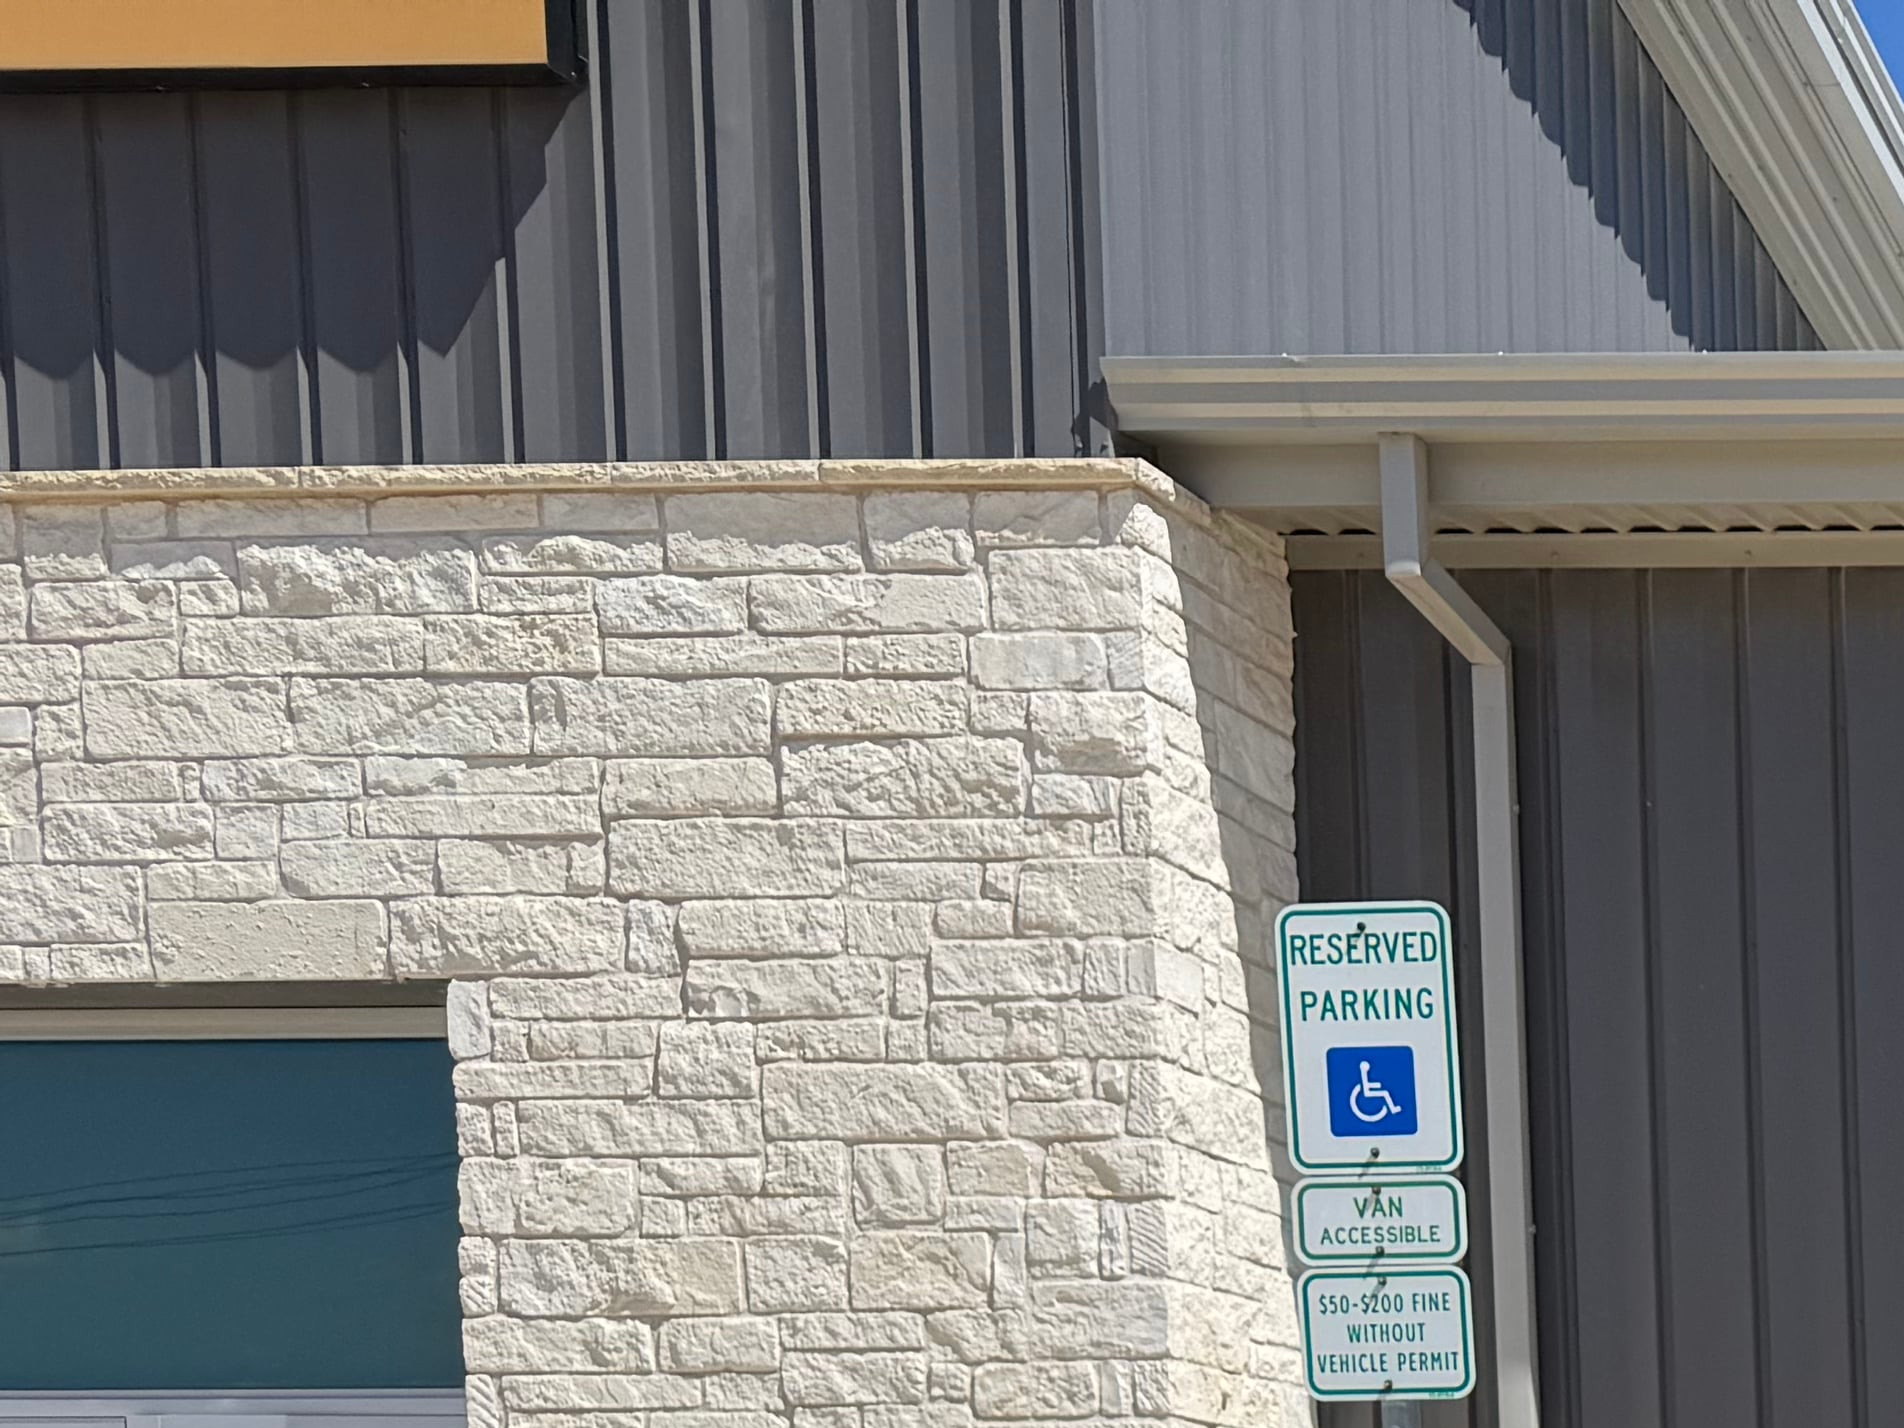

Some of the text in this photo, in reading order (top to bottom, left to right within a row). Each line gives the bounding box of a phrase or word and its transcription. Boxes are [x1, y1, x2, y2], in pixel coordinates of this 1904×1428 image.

[1289, 931, 1438, 966] RESERVED
[1300, 987, 1434, 1021] PARKING
[1354, 1196, 1403, 1219] VAN
[1320, 1225, 1441, 1245] ACCESSIBLE
[1318, 1292, 1451, 1316] $50-$200 FINE
[1347, 1322, 1426, 1343] WITHOUT
[1317, 1351, 1460, 1374] VEHICLE PERMIT
